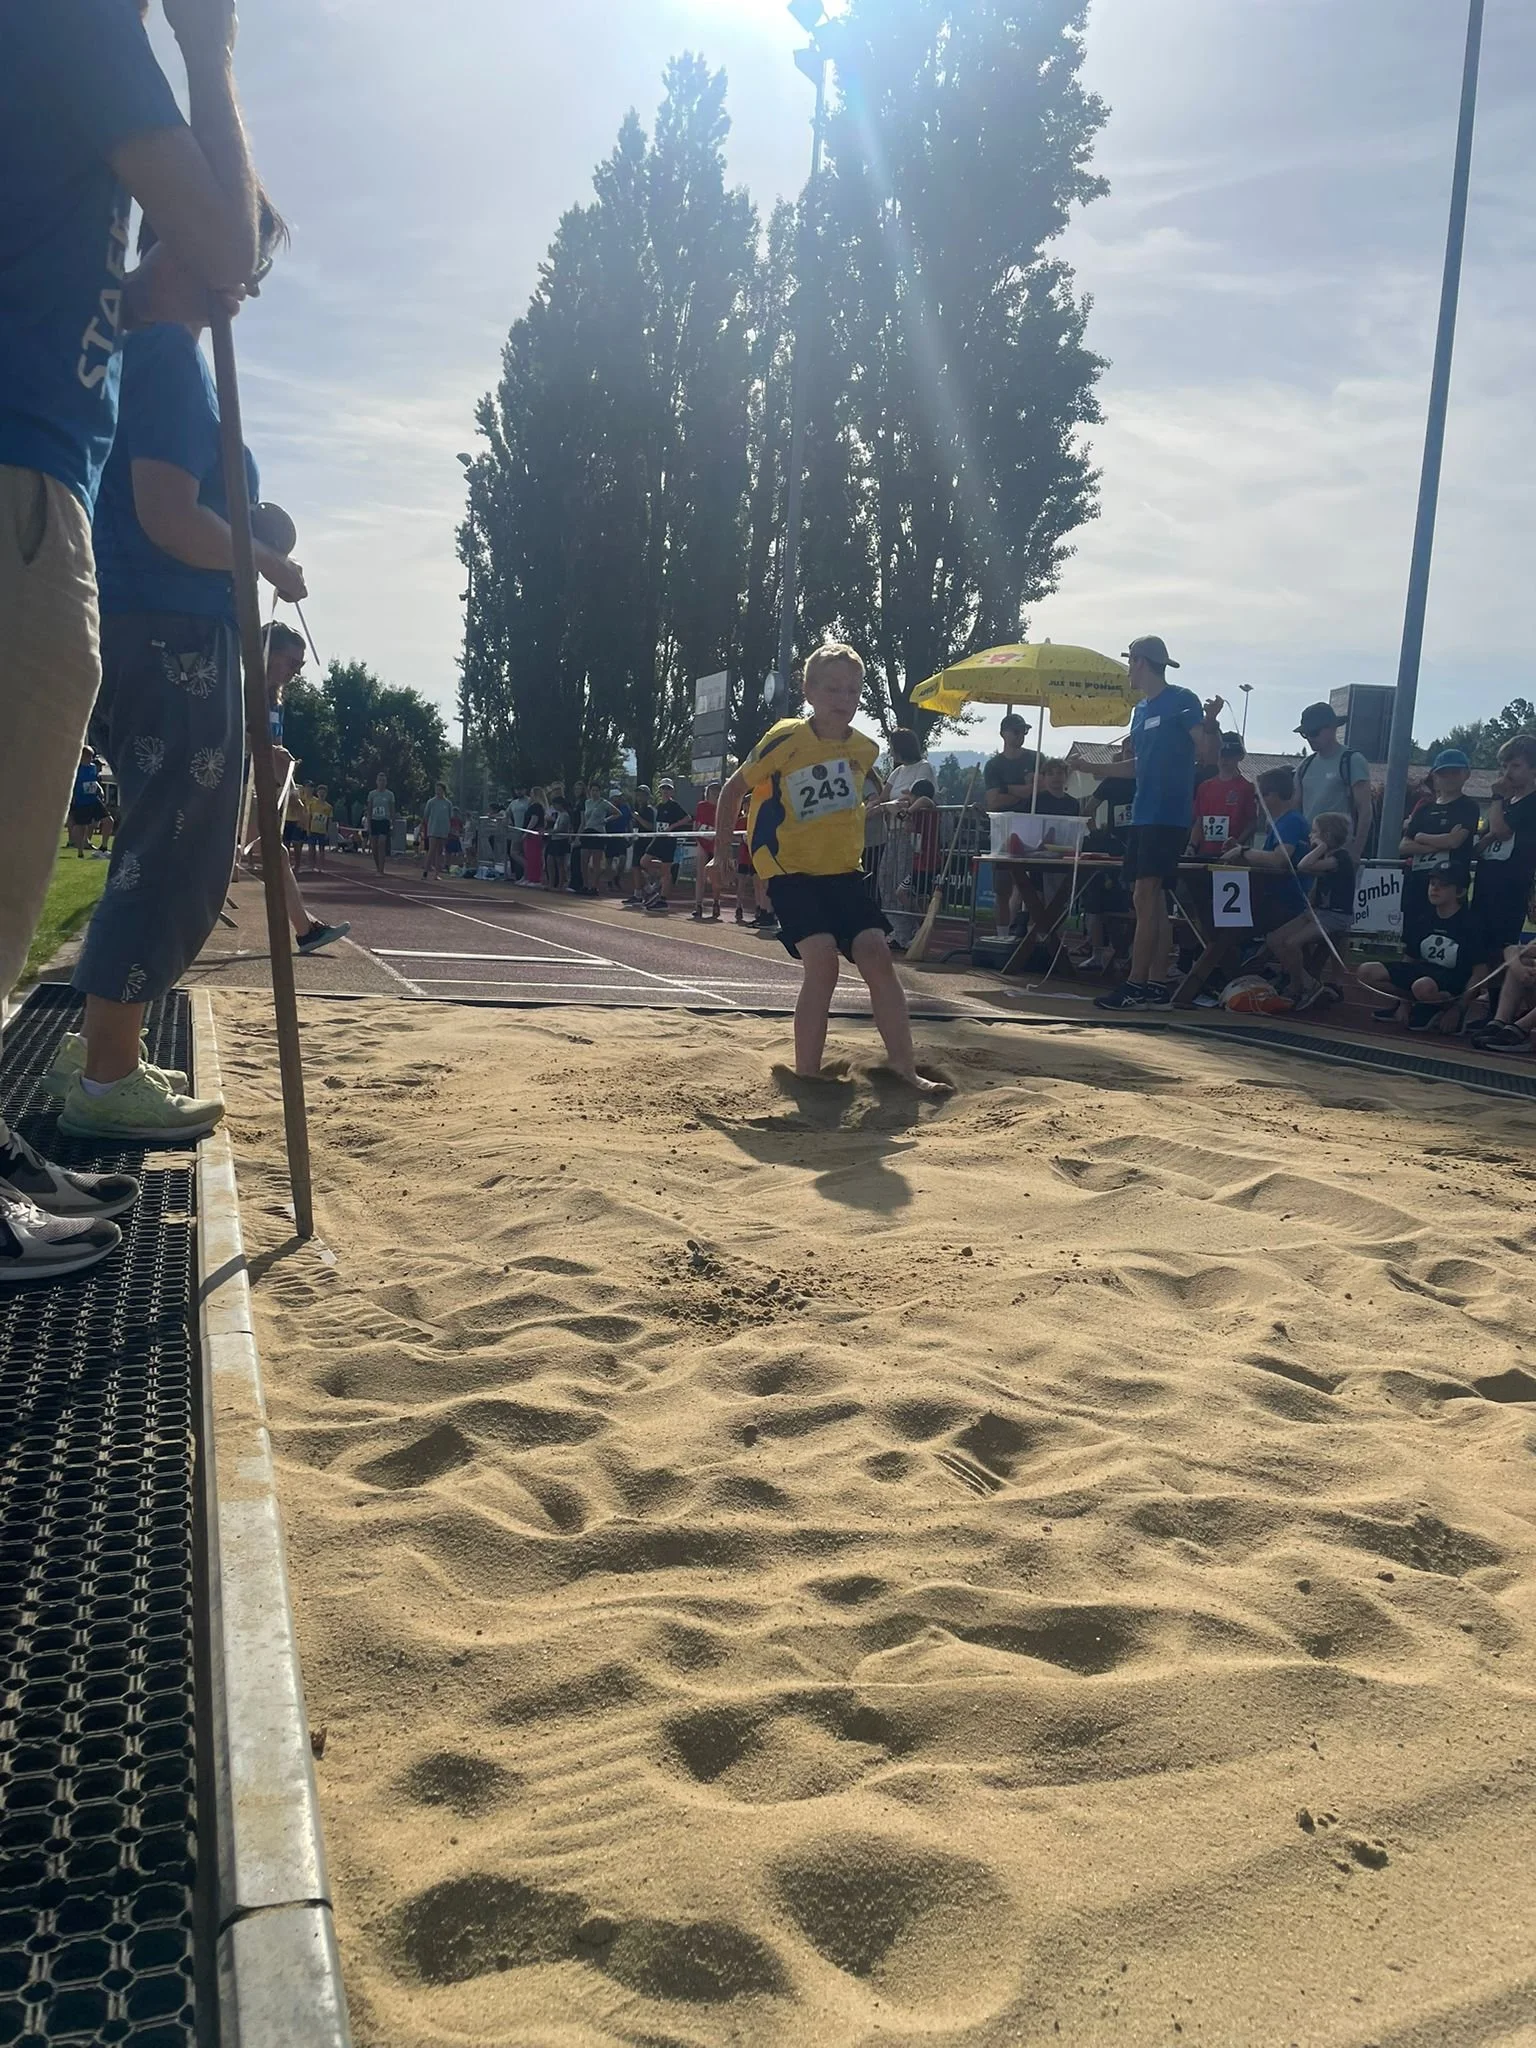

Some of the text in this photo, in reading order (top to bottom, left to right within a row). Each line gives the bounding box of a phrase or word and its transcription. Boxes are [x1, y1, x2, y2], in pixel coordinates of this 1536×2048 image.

[800, 778, 849, 808] 243
[1118, 811, 1133, 821] 19
[1204, 825, 1224, 836] 212
[1222, 881, 1241, 913] 2
[1358, 874, 1400, 908] gmbh
[1427, 946, 1445, 961] 24
